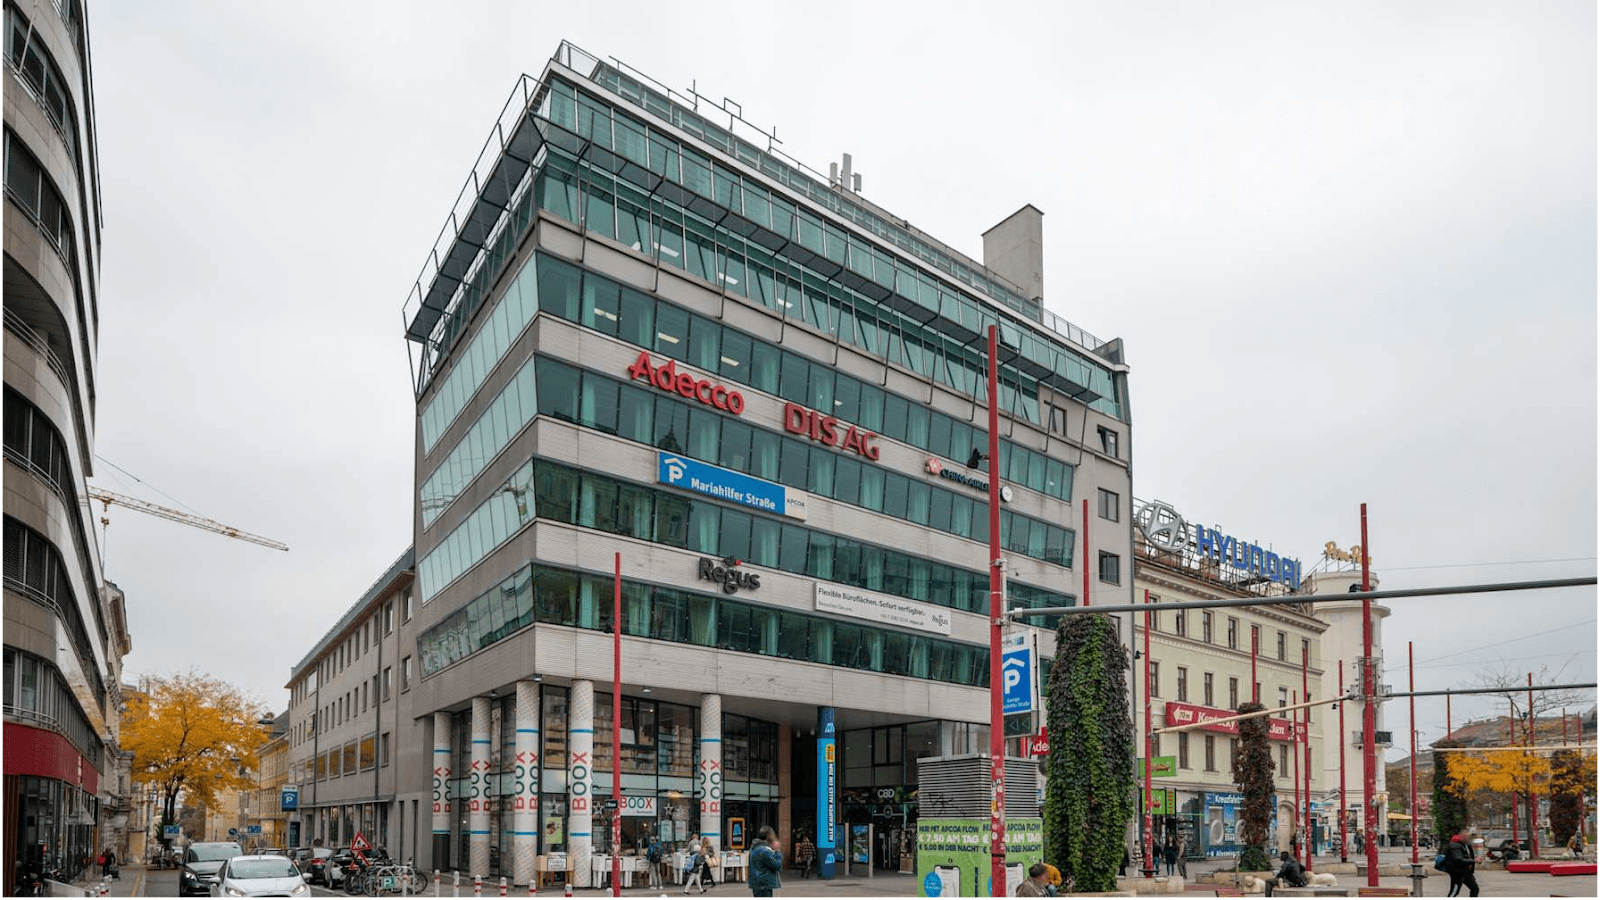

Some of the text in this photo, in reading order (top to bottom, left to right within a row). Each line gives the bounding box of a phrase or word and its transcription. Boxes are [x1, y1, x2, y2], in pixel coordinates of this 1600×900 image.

[628, 351, 744, 415] Adecco
[785, 402, 880, 461] DIS AG
[691, 477, 776, 510] Mariahilfer Straße
[1196, 524, 1301, 590] HYUNDAI
[699, 556, 761, 594] Regus
[818, 588, 925, 616] Flexible Büroflächen. Sofort verfügbar.
[1032, 743, 1048, 753] Ade
[573, 752, 587, 810] BOOX
[877, 788, 895, 799] CBD
[620, 797, 652, 809] BOOX
[946, 834, 960, 843] AM
[962, 834, 980, 844] TAG
[1007, 823, 1040, 831] APCOA FLOW
[1012, 833, 1025, 843] AM
[1026, 833, 1041, 843] TAG
